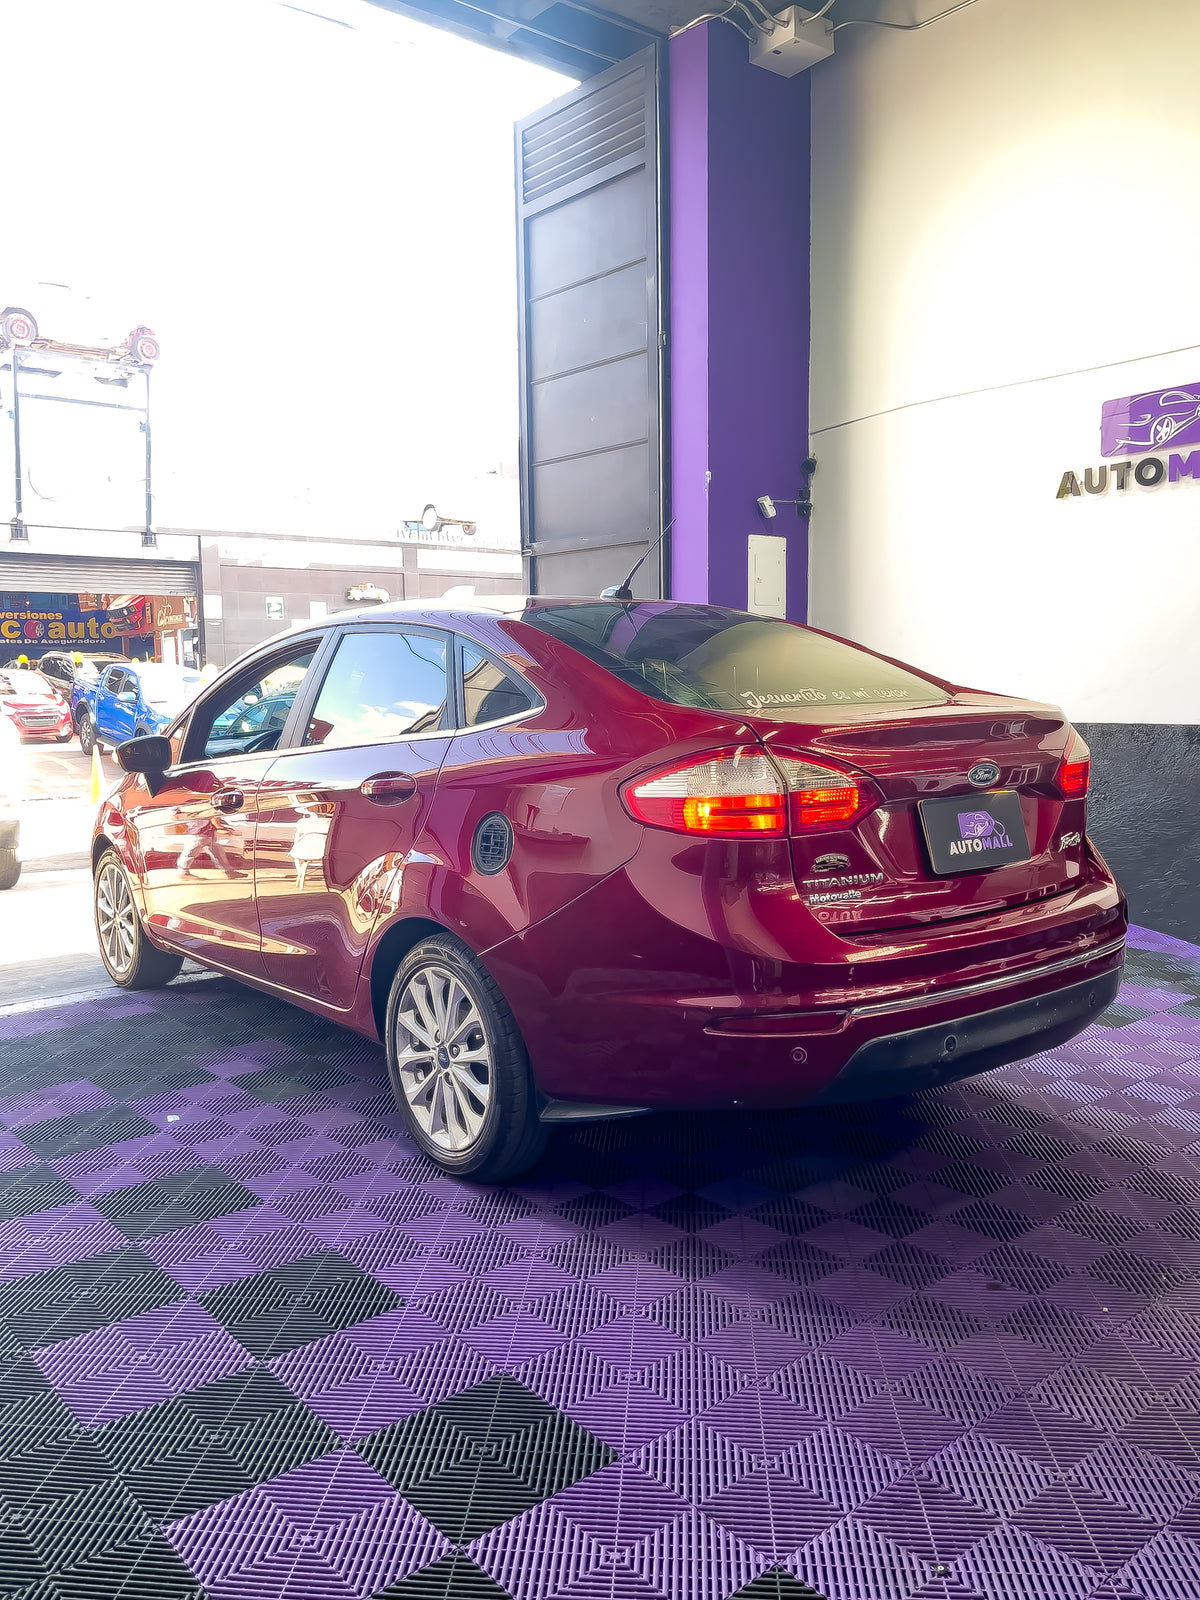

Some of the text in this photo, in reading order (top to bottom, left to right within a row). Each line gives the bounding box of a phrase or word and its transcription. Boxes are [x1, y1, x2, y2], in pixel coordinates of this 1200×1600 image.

[1056, 451, 1200, 499] AUTOM
[0, 611, 63, 620] versiones
[831, 690, 851, 700] es
[852, 687, 873, 700] mi
[950, 834, 1014, 857] AUTOMALL
[802, 872, 884, 889] TITANIUM
[809, 889, 862, 905] Motovalle
